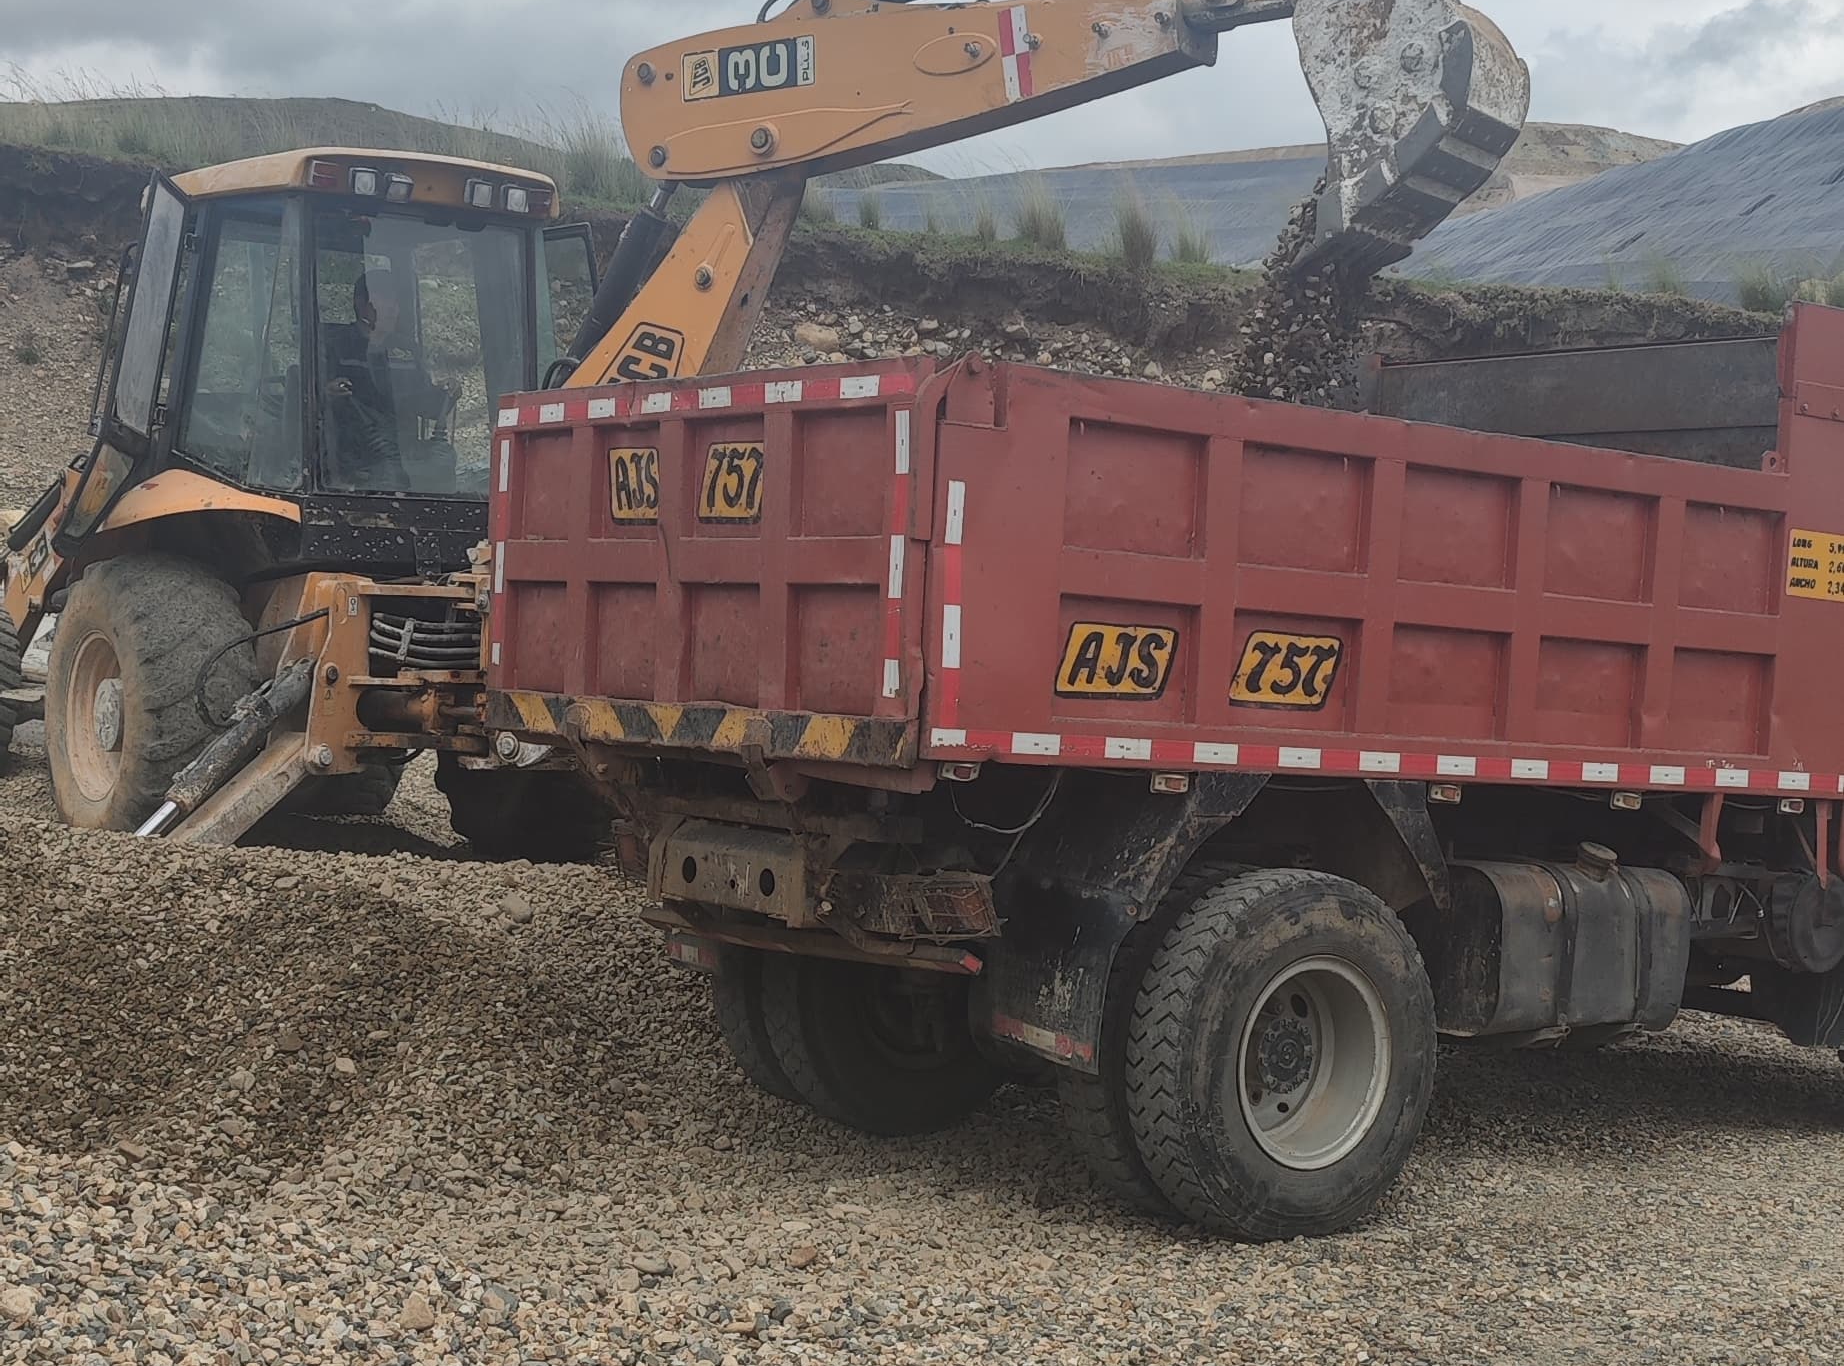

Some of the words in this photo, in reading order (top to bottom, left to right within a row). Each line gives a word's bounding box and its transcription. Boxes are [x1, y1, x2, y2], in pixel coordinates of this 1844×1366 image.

[692, 59, 711, 88] JCB
[728, 43, 788, 91] 3C
[607, 331, 675, 384] CB
[615, 450, 660, 511] AJS
[706, 446, 764, 512] 757
[1789, 577, 1816, 589] ANCHO
[1790, 556, 1819, 570] ALTURA
[1066, 631, 1168, 689] AJS
[1245, 640, 1338, 697] 757
